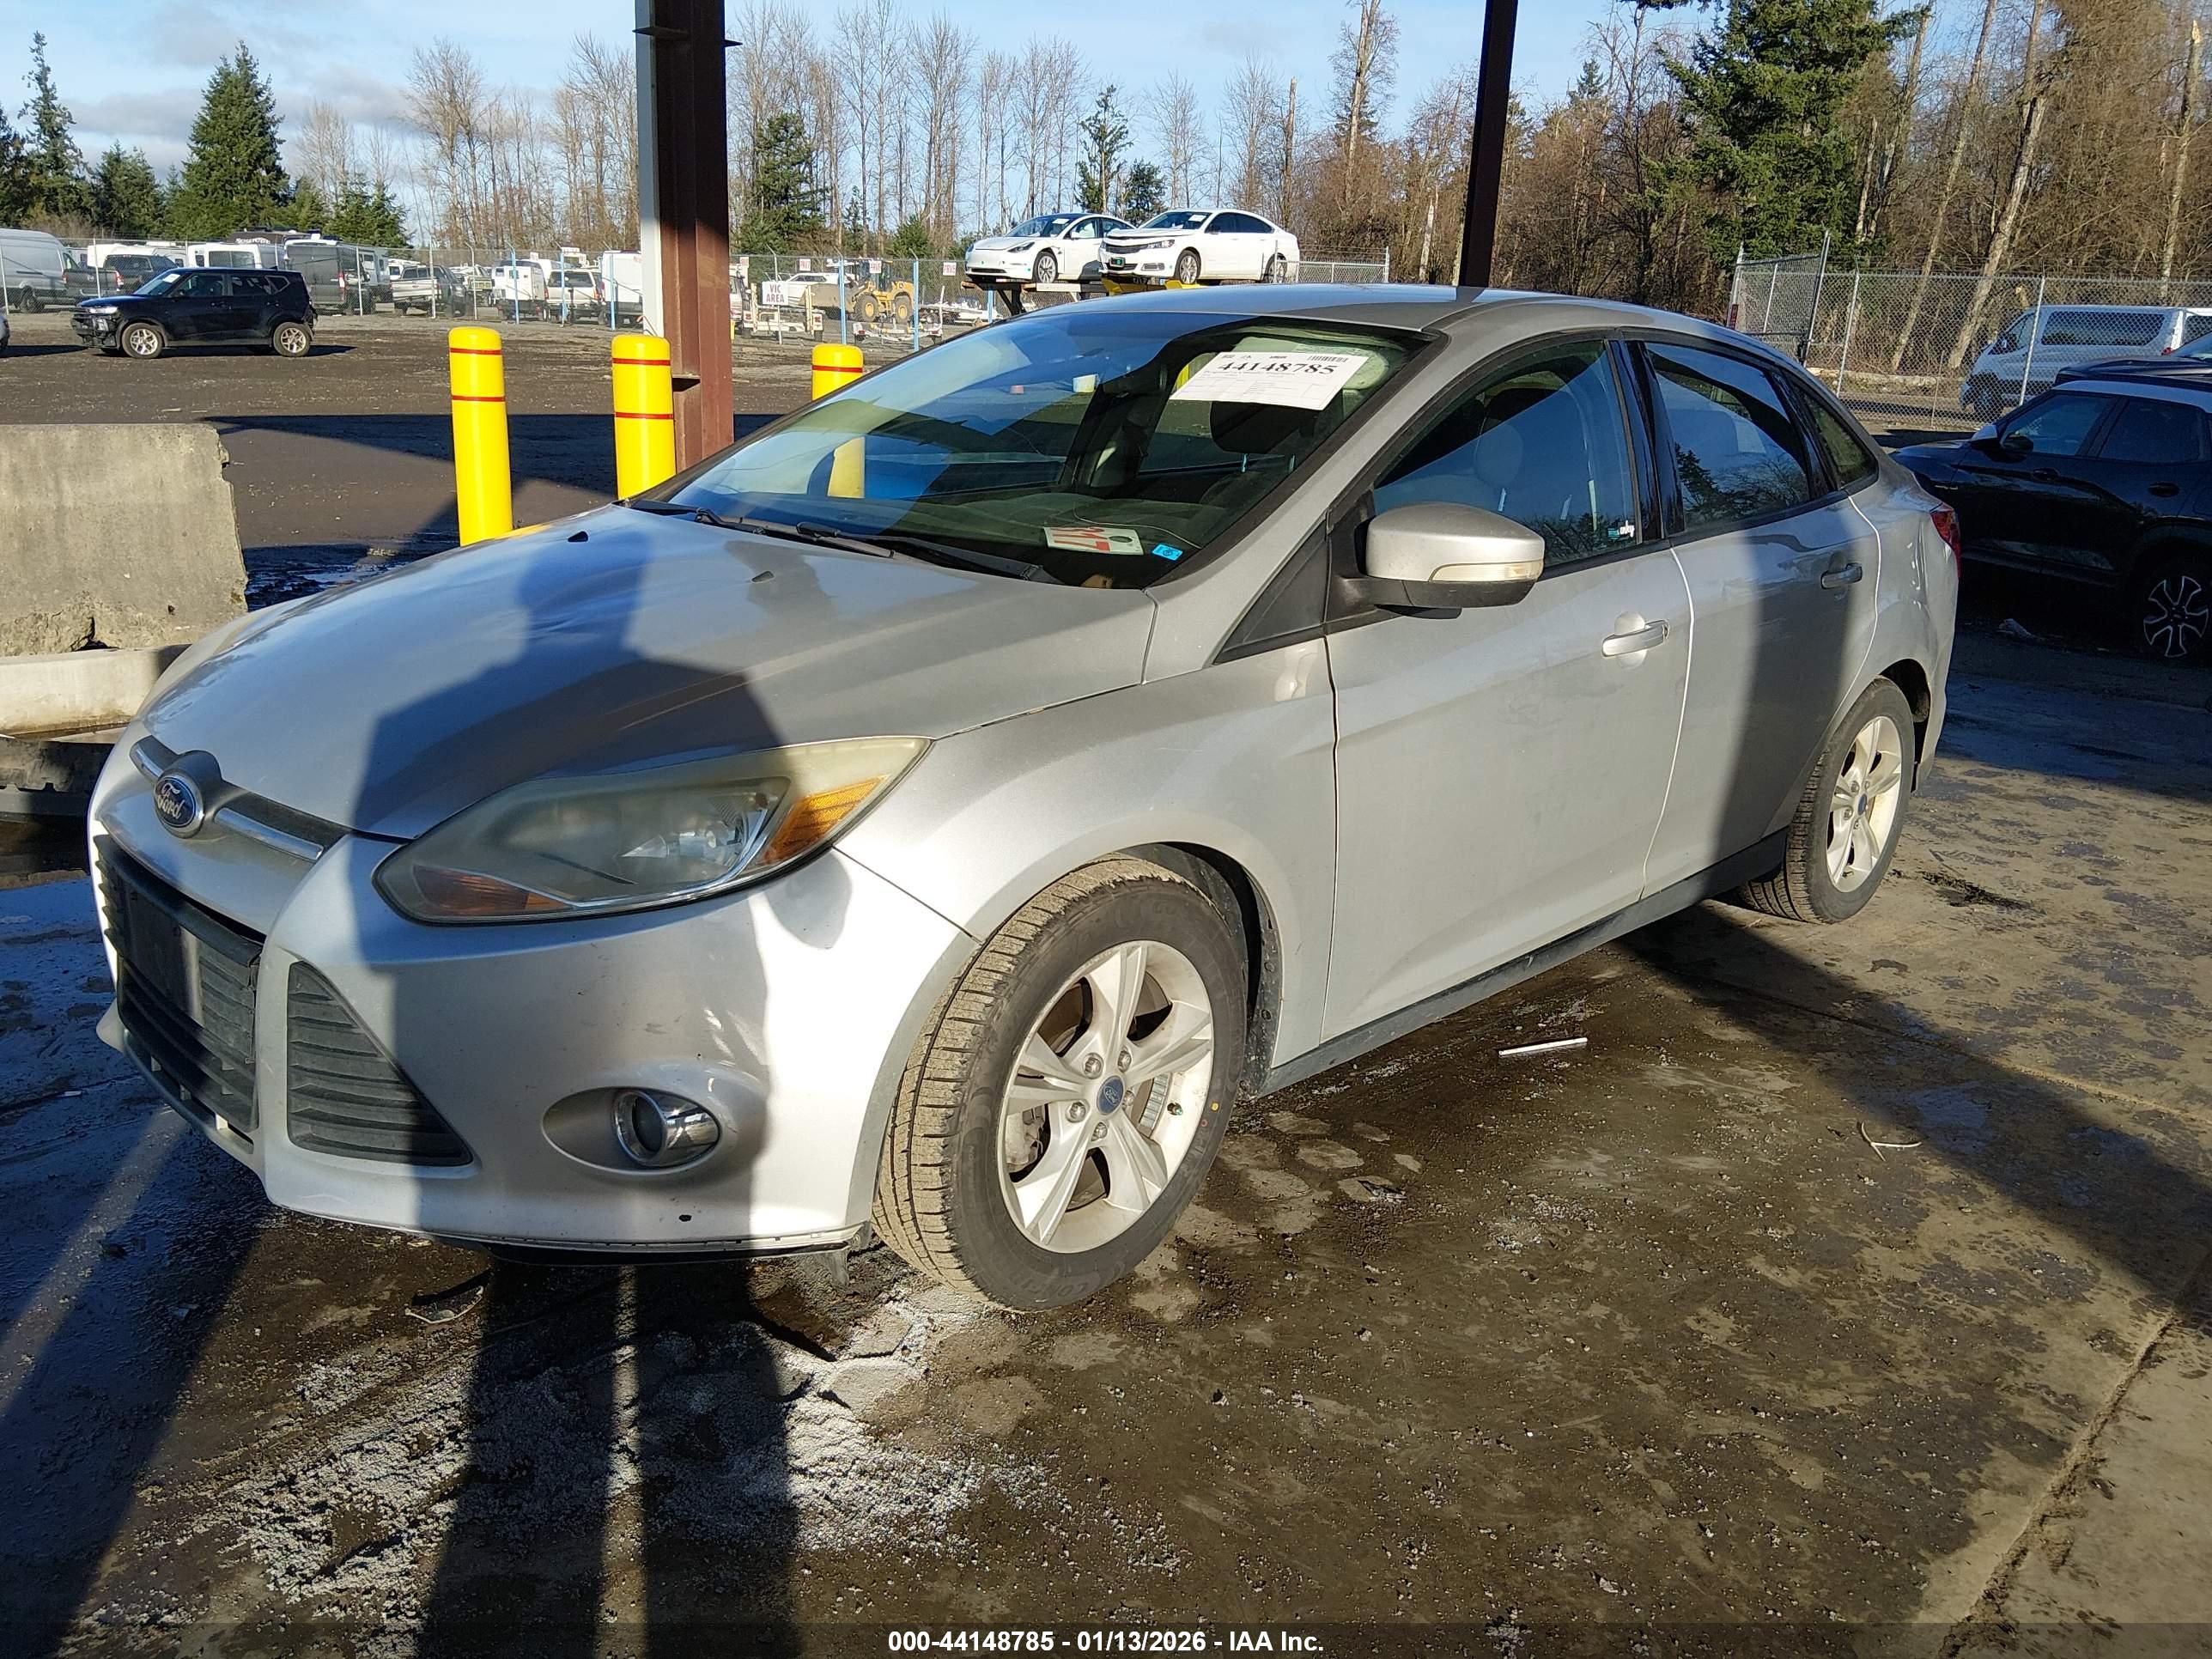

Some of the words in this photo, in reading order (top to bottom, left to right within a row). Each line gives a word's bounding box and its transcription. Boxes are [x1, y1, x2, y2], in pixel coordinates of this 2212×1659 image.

[769, 284, 781, 294] VIC
[766, 294, 785, 303] AREA
[1218, 362, 1339, 375] 44148785
[156, 782, 185, 820] Ford
